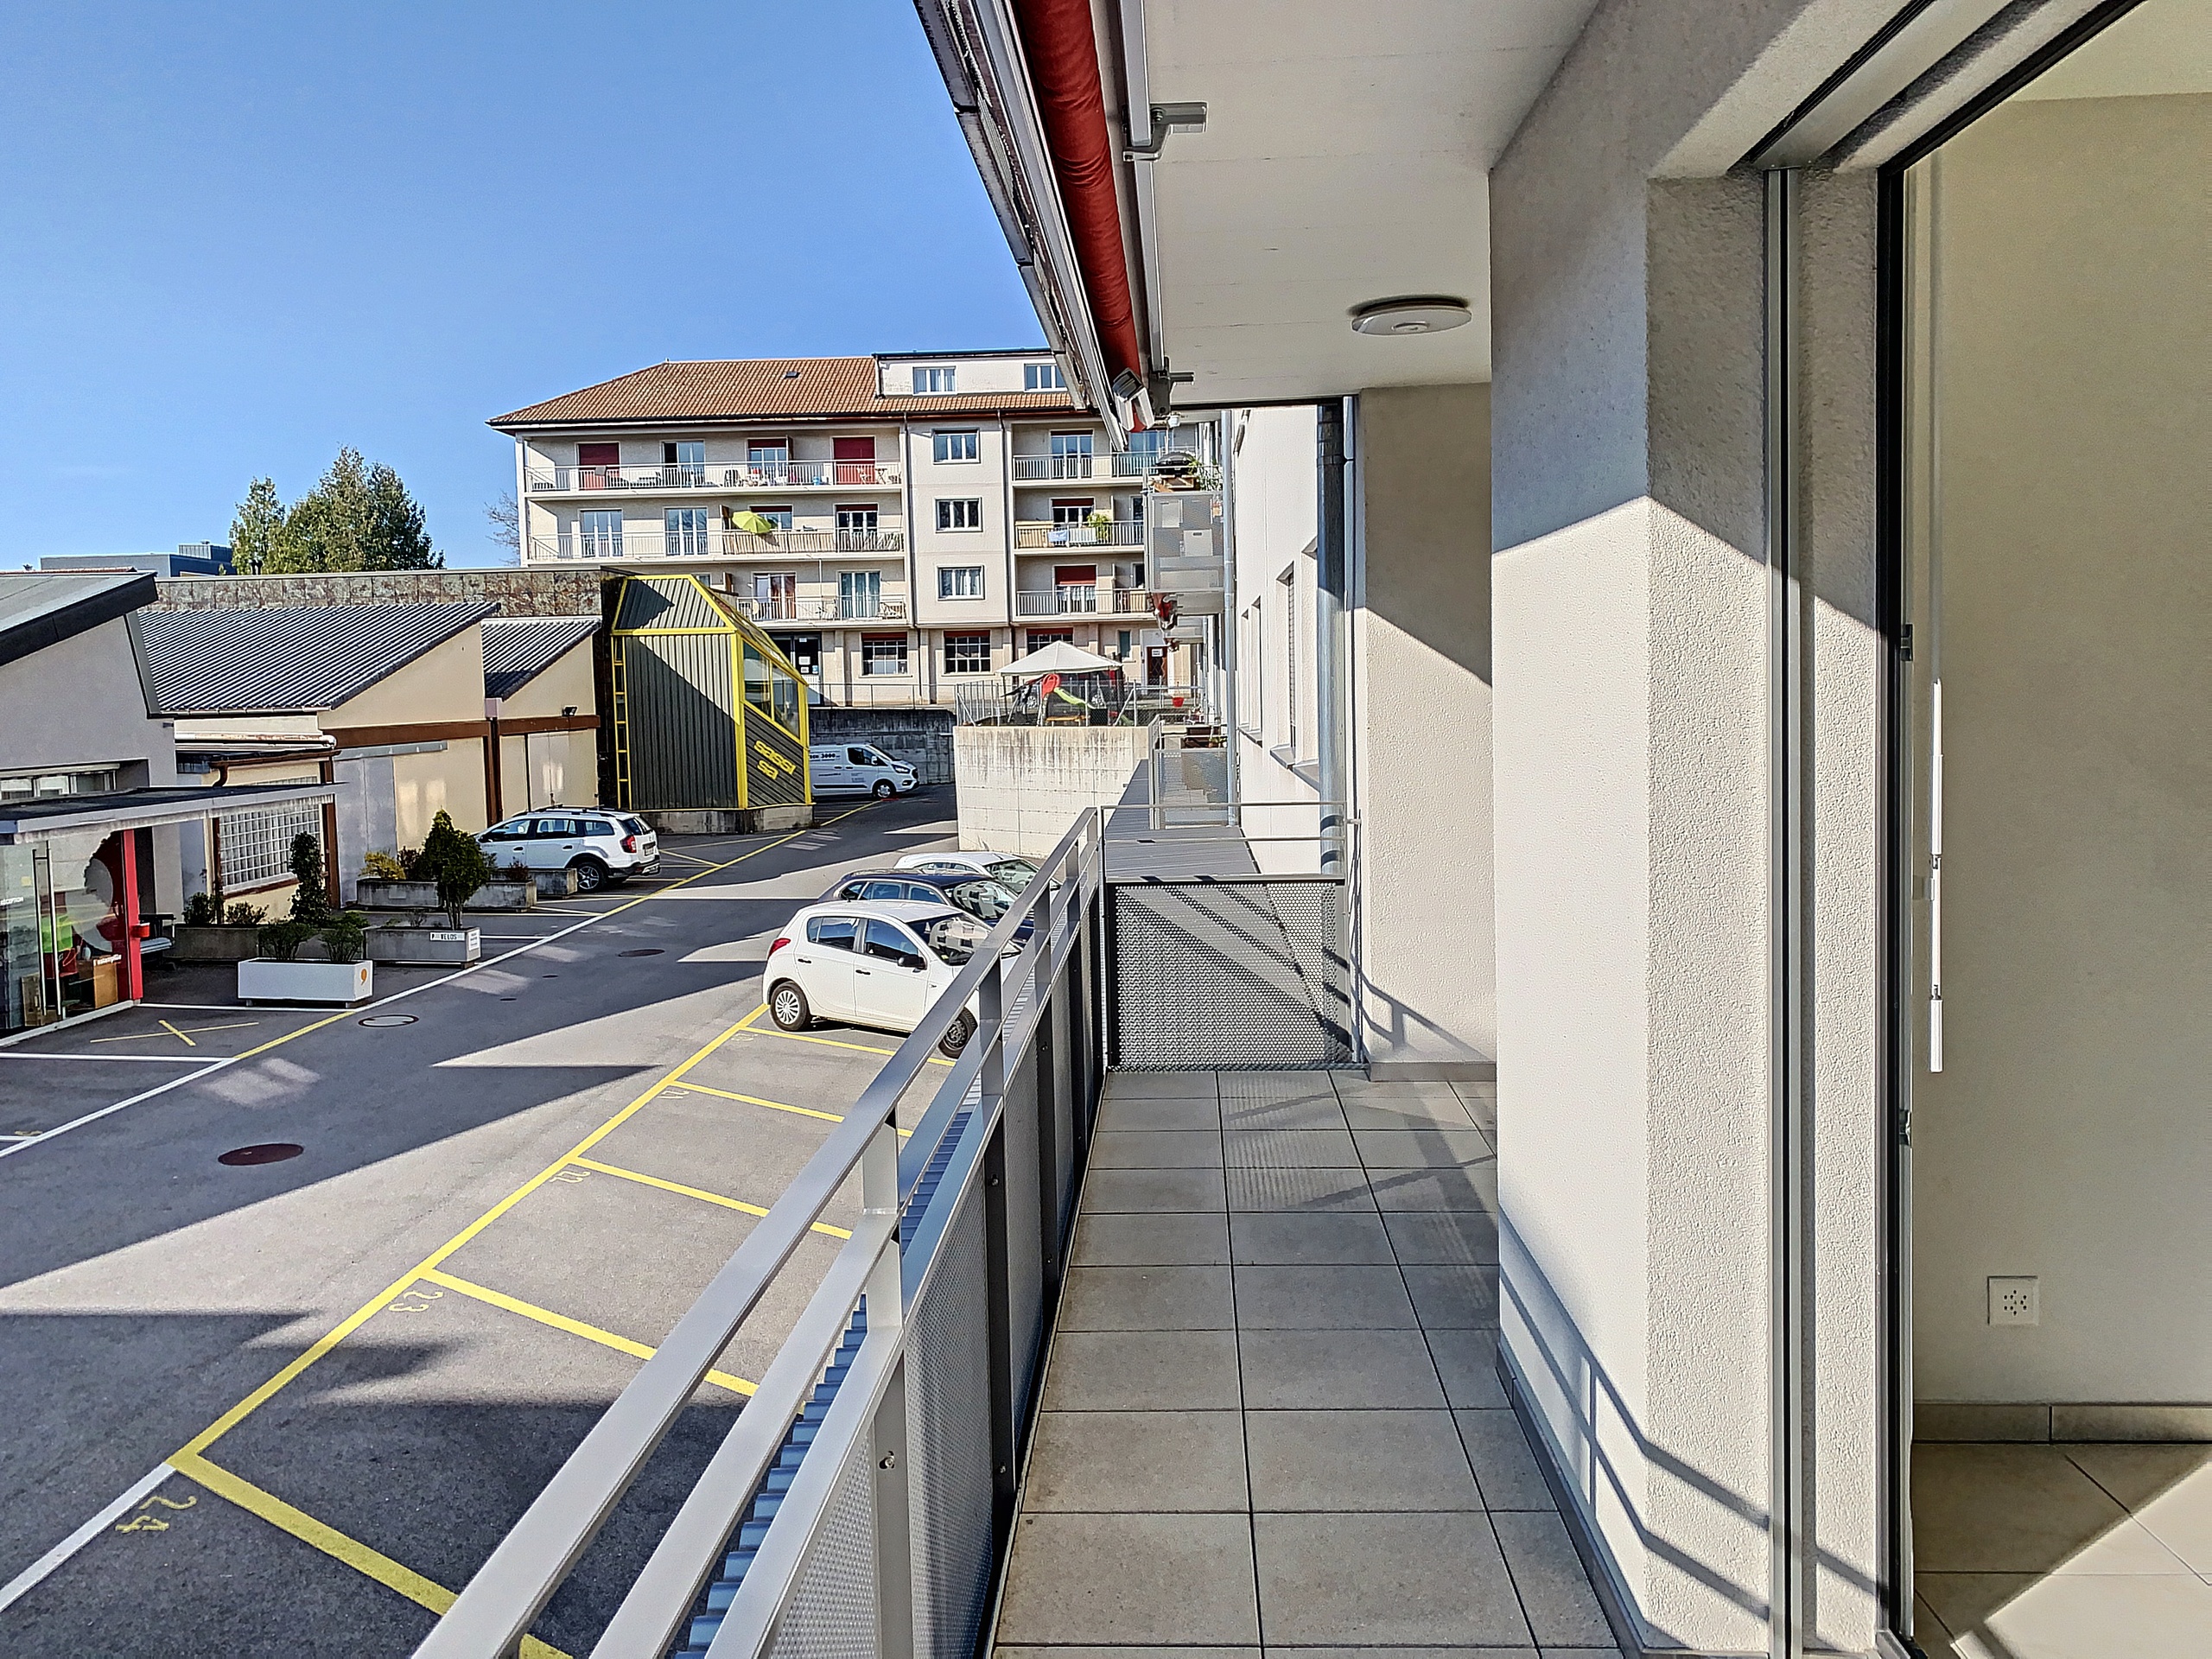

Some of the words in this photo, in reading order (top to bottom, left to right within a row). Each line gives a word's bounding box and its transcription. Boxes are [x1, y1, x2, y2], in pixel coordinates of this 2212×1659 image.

[753, 740, 796, 775] sassi
[757, 760, 779, 780] sa
[657, 1090, 690, 1099] 21
[549, 1170, 591, 1183] 22
[388, 1291, 444, 1313] 23
[115, 1495, 198, 1534] 24
